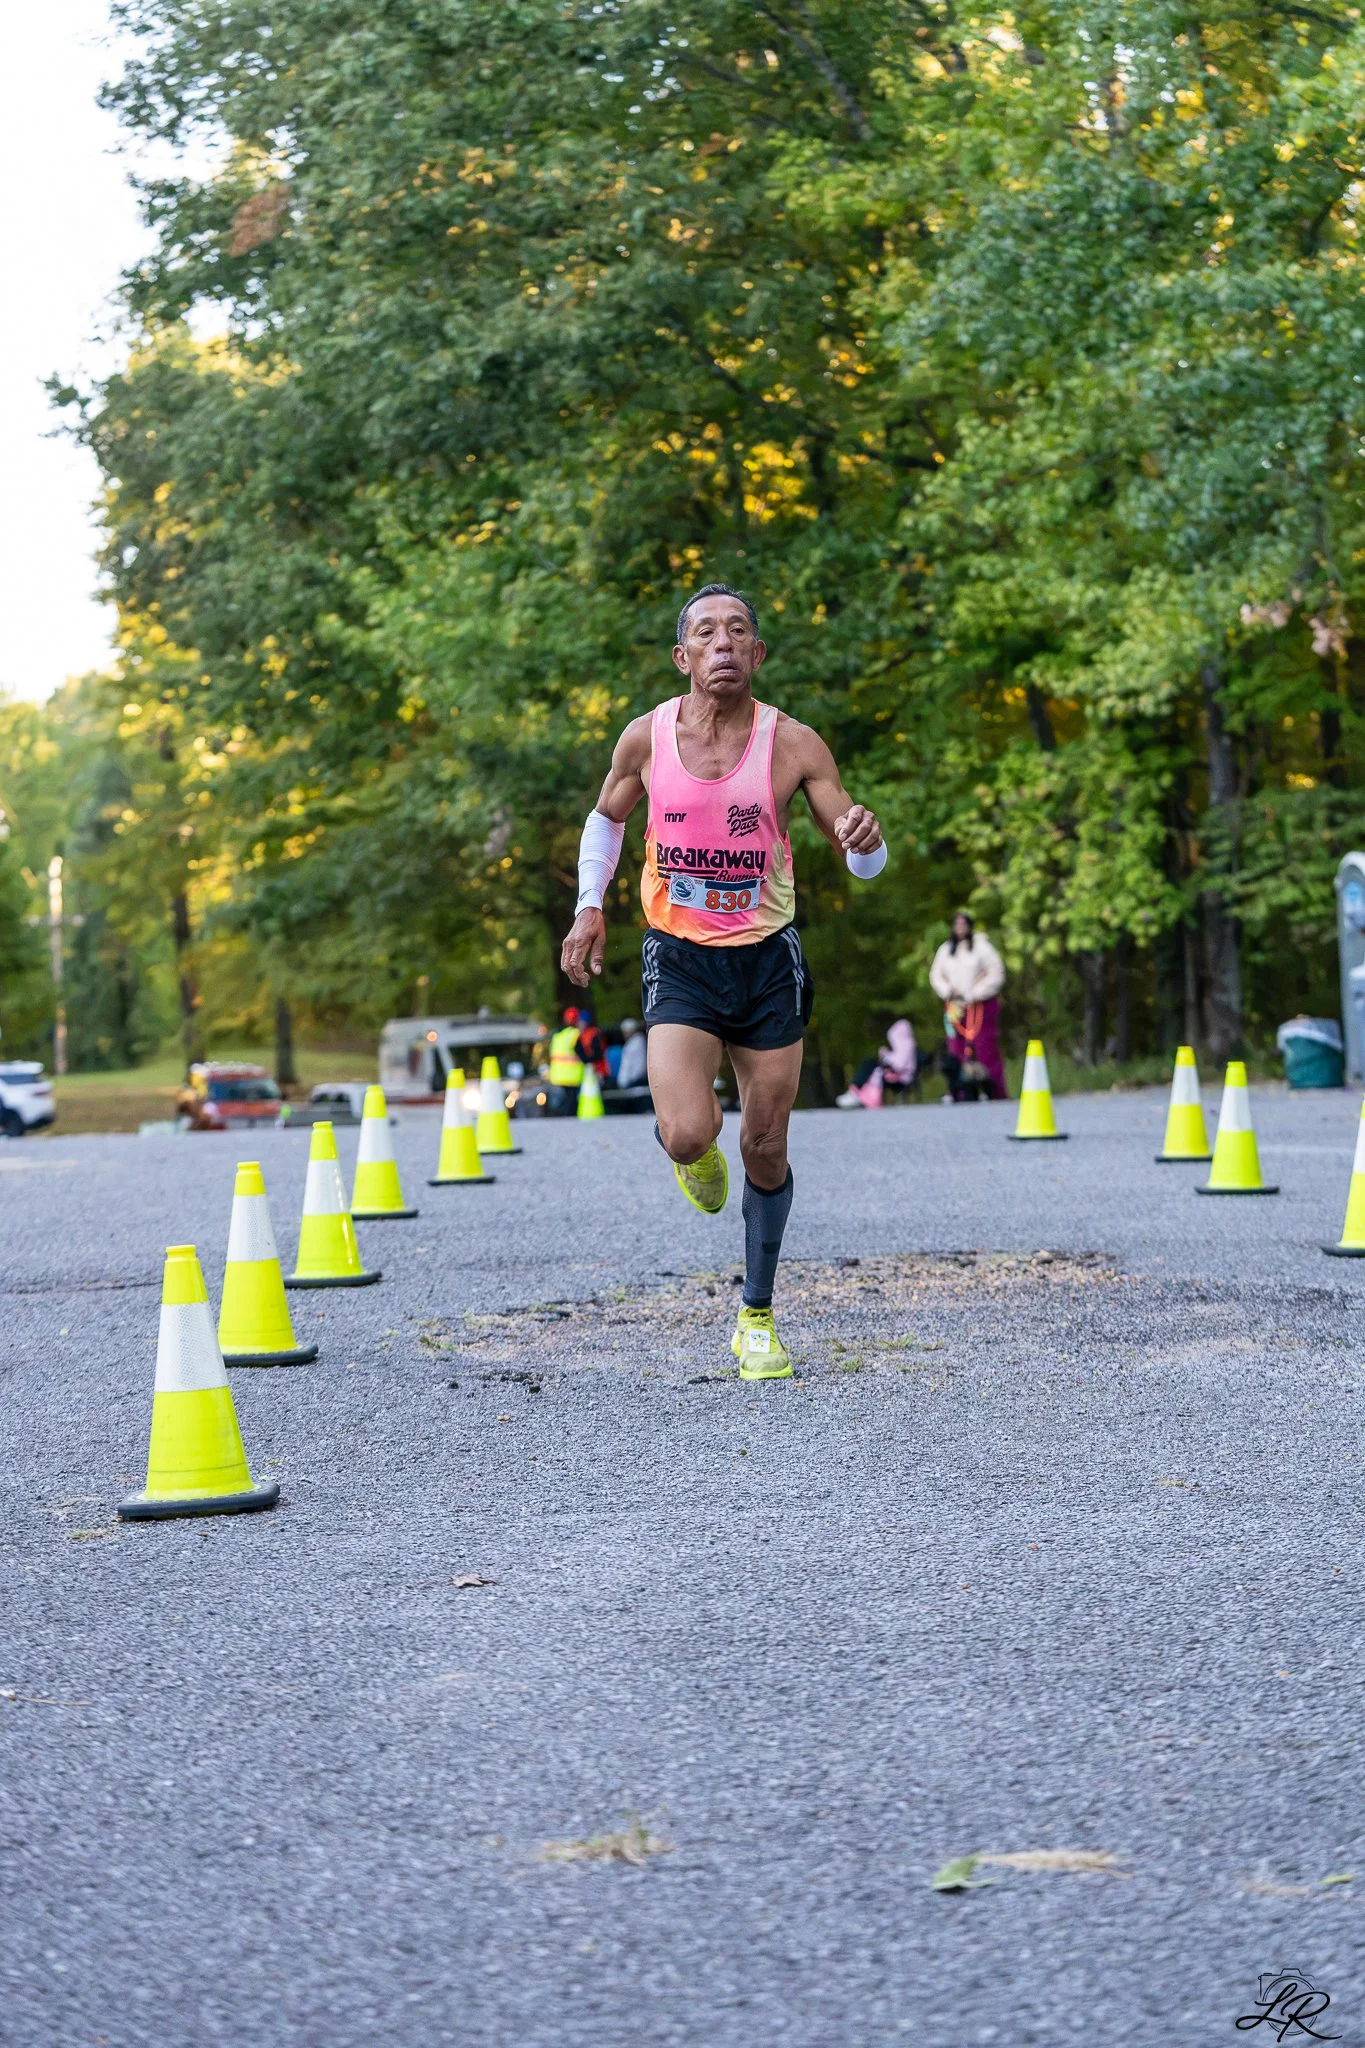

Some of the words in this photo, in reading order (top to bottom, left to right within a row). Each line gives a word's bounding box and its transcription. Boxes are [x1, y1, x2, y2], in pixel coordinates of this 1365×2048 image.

[727, 803, 762, 824] Party
[729, 819, 759, 838] Pace
[657, 842, 766, 874] Breakaway
[705, 889, 751, 911] 830
